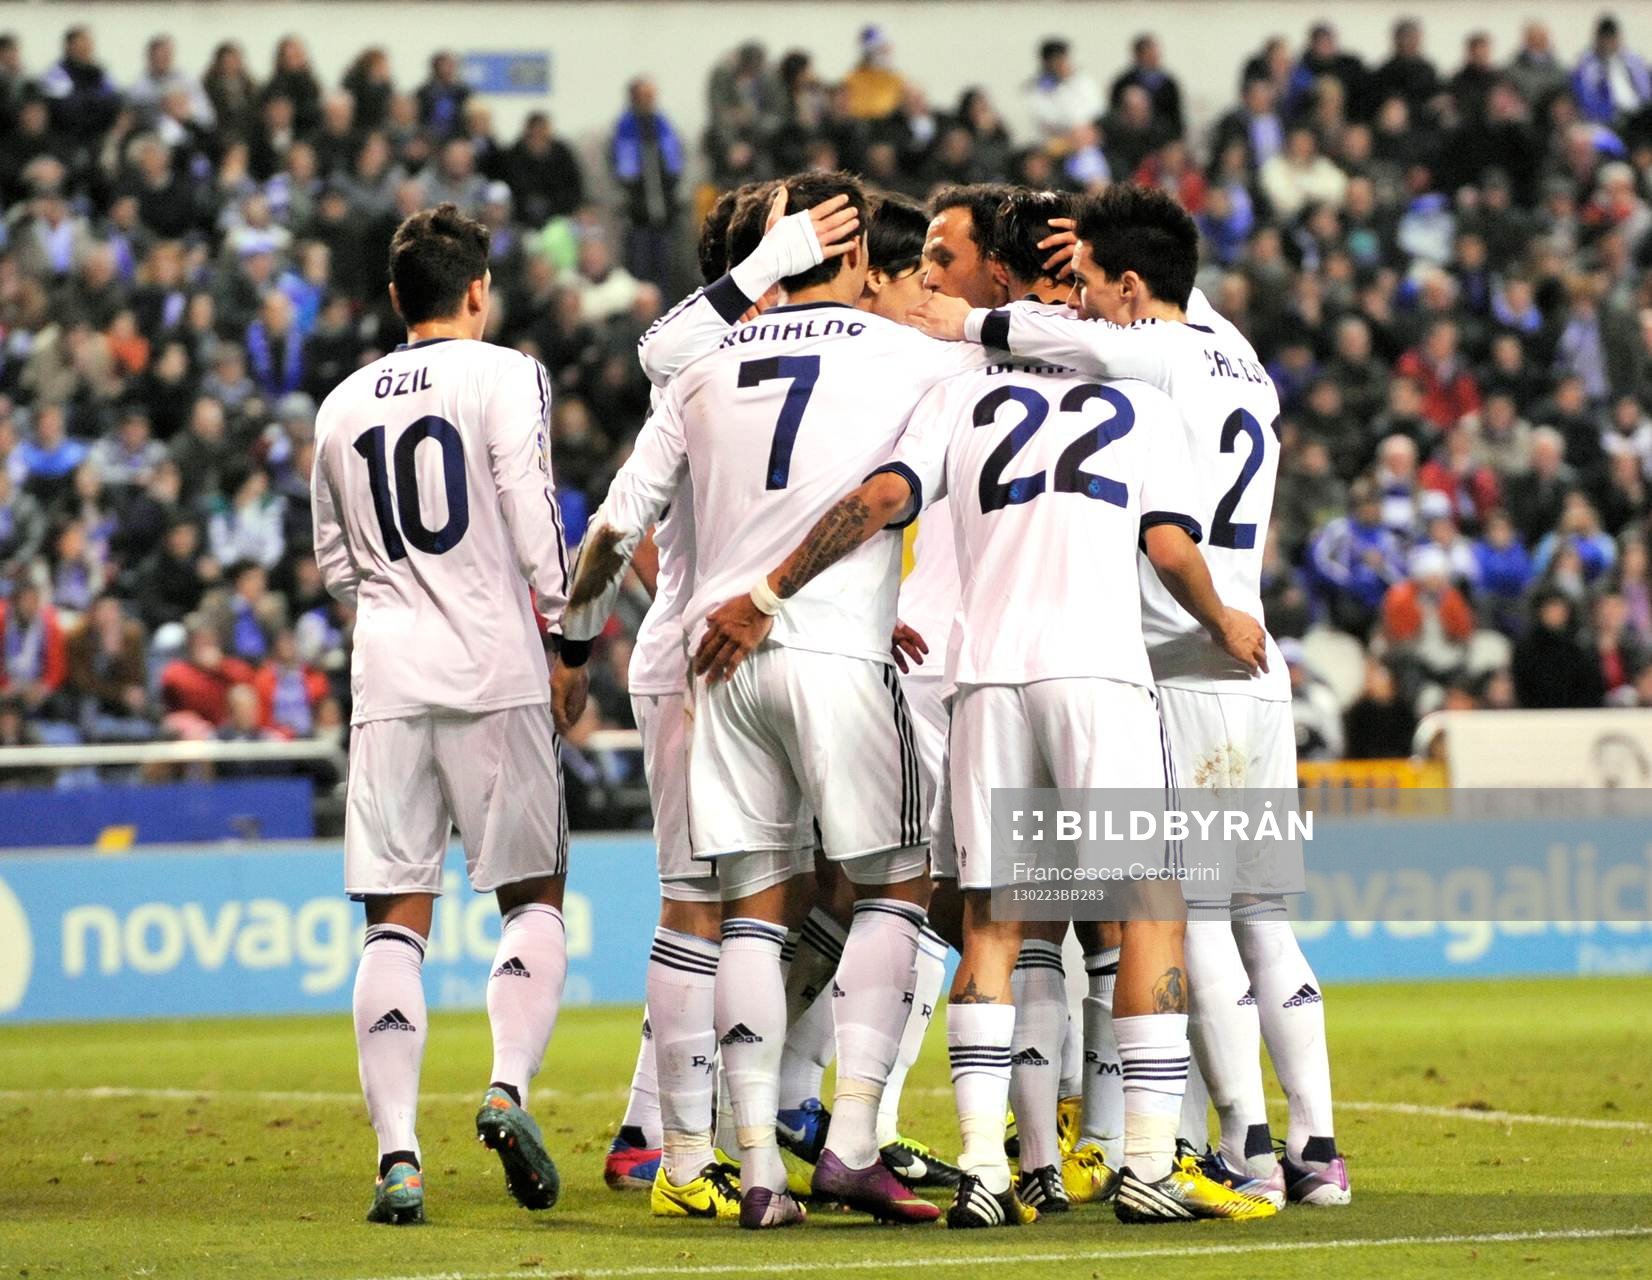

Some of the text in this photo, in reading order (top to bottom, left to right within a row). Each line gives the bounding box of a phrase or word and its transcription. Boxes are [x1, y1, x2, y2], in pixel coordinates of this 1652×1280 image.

[374, 366, 432, 399] ÖZIL
[737, 355, 821, 491] 7
[973, 383, 1136, 515] 22
[352, 415, 469, 562] 10
[1208, 407, 1281, 550] 2
[368, 1020, 417, 1034] adidas
